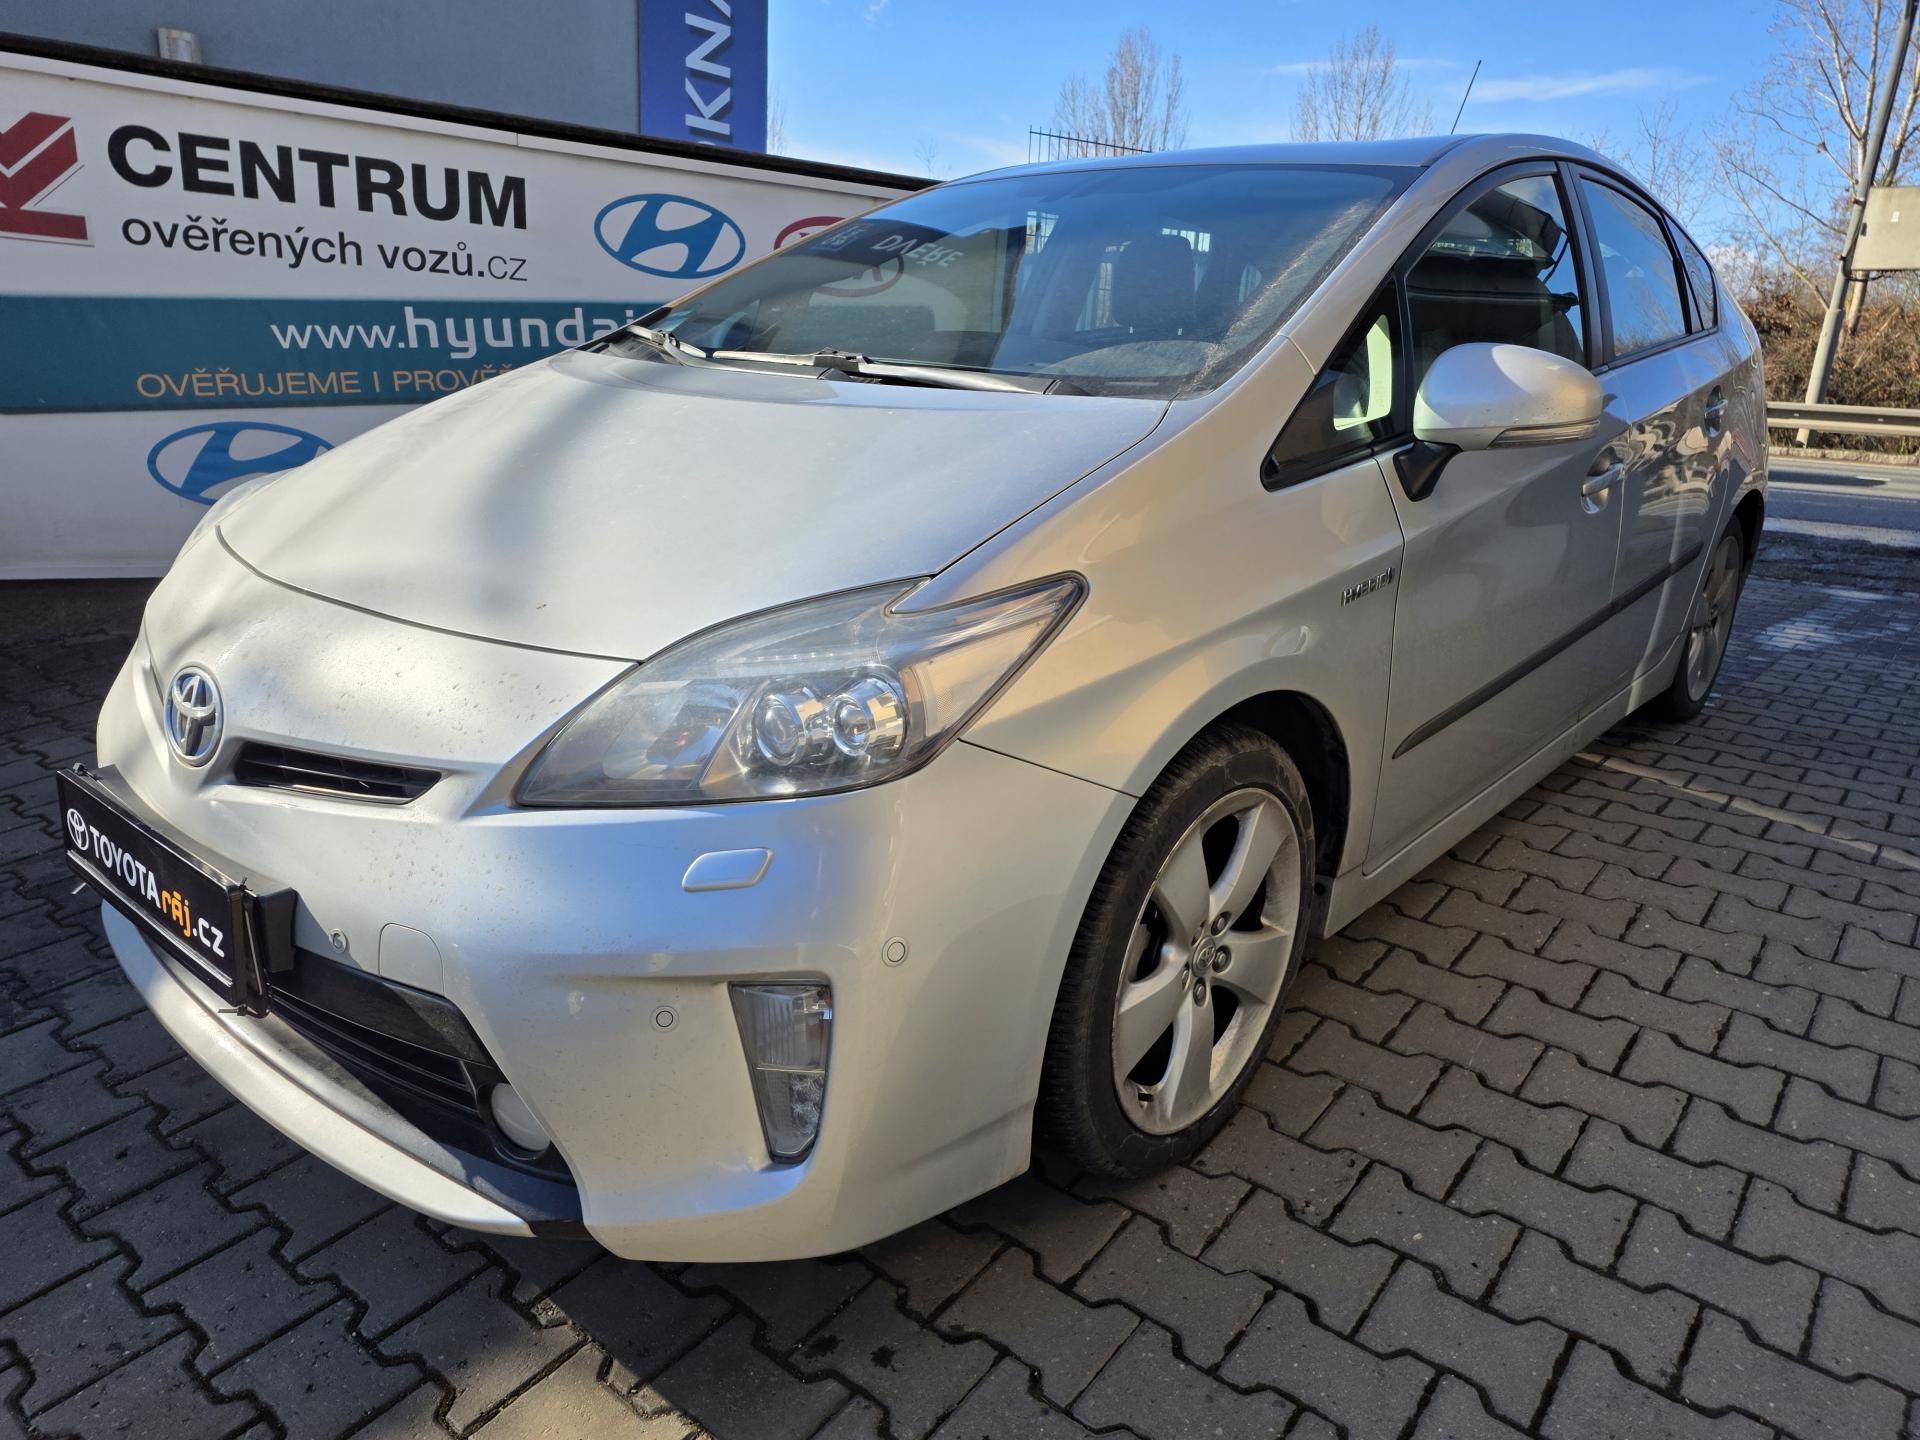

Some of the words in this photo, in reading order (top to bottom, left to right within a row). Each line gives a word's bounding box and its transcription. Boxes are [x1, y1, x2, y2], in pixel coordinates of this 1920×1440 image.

[685, 0, 731, 145] KN
[107, 124, 528, 230] CENTRUM
[121, 214, 363, 269] ověřených
[377, 241, 528, 282] vozů.cz
[136, 367, 361, 398] OVĚŘUJEME
[1341, 567, 1396, 609] HYBRID
